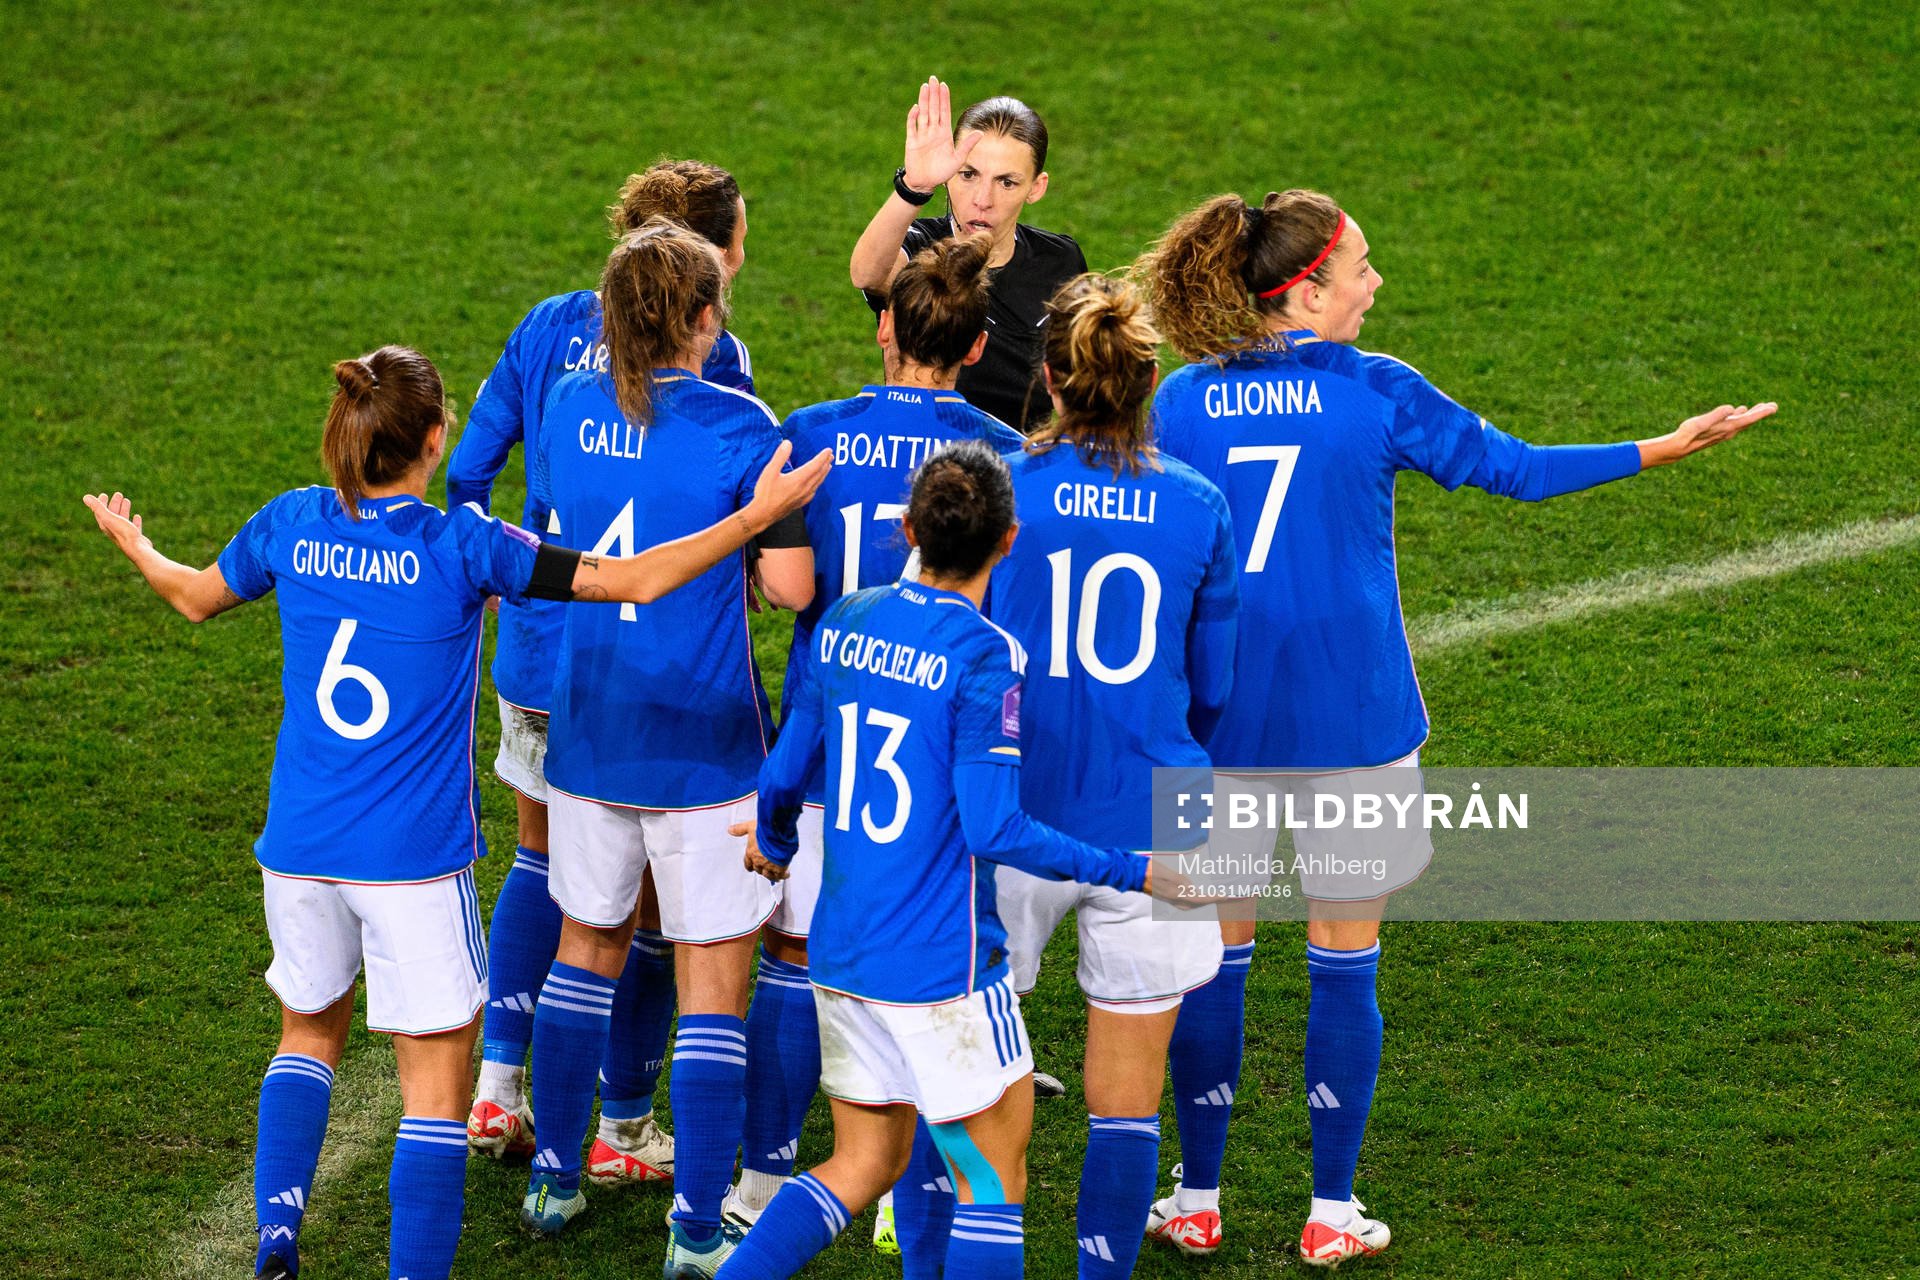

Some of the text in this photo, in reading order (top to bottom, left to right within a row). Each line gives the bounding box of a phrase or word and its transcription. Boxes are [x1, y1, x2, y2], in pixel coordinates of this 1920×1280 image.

[564, 336, 610, 373] CAR
[887, 391, 922, 404] ITALIA
[1205, 380, 1322, 418] GLIONNA
[579, 418, 645, 460] GALLI
[1054, 482, 1156, 524] GIRELLI
[1227, 445, 1301, 572] 7
[293, 539, 420, 585] GIUGLIANO
[590, 497, 637, 622] 4
[900, 587, 927, 606] ITALIA
[1046, 548, 1162, 685] 10
[316, 618, 390, 740] 6
[839, 632, 948, 691] GUGLIELMO
[835, 702, 912, 844] 13
[645, 1059, 664, 1072] ITA
[537, 1184, 548, 1213] LOTTO
